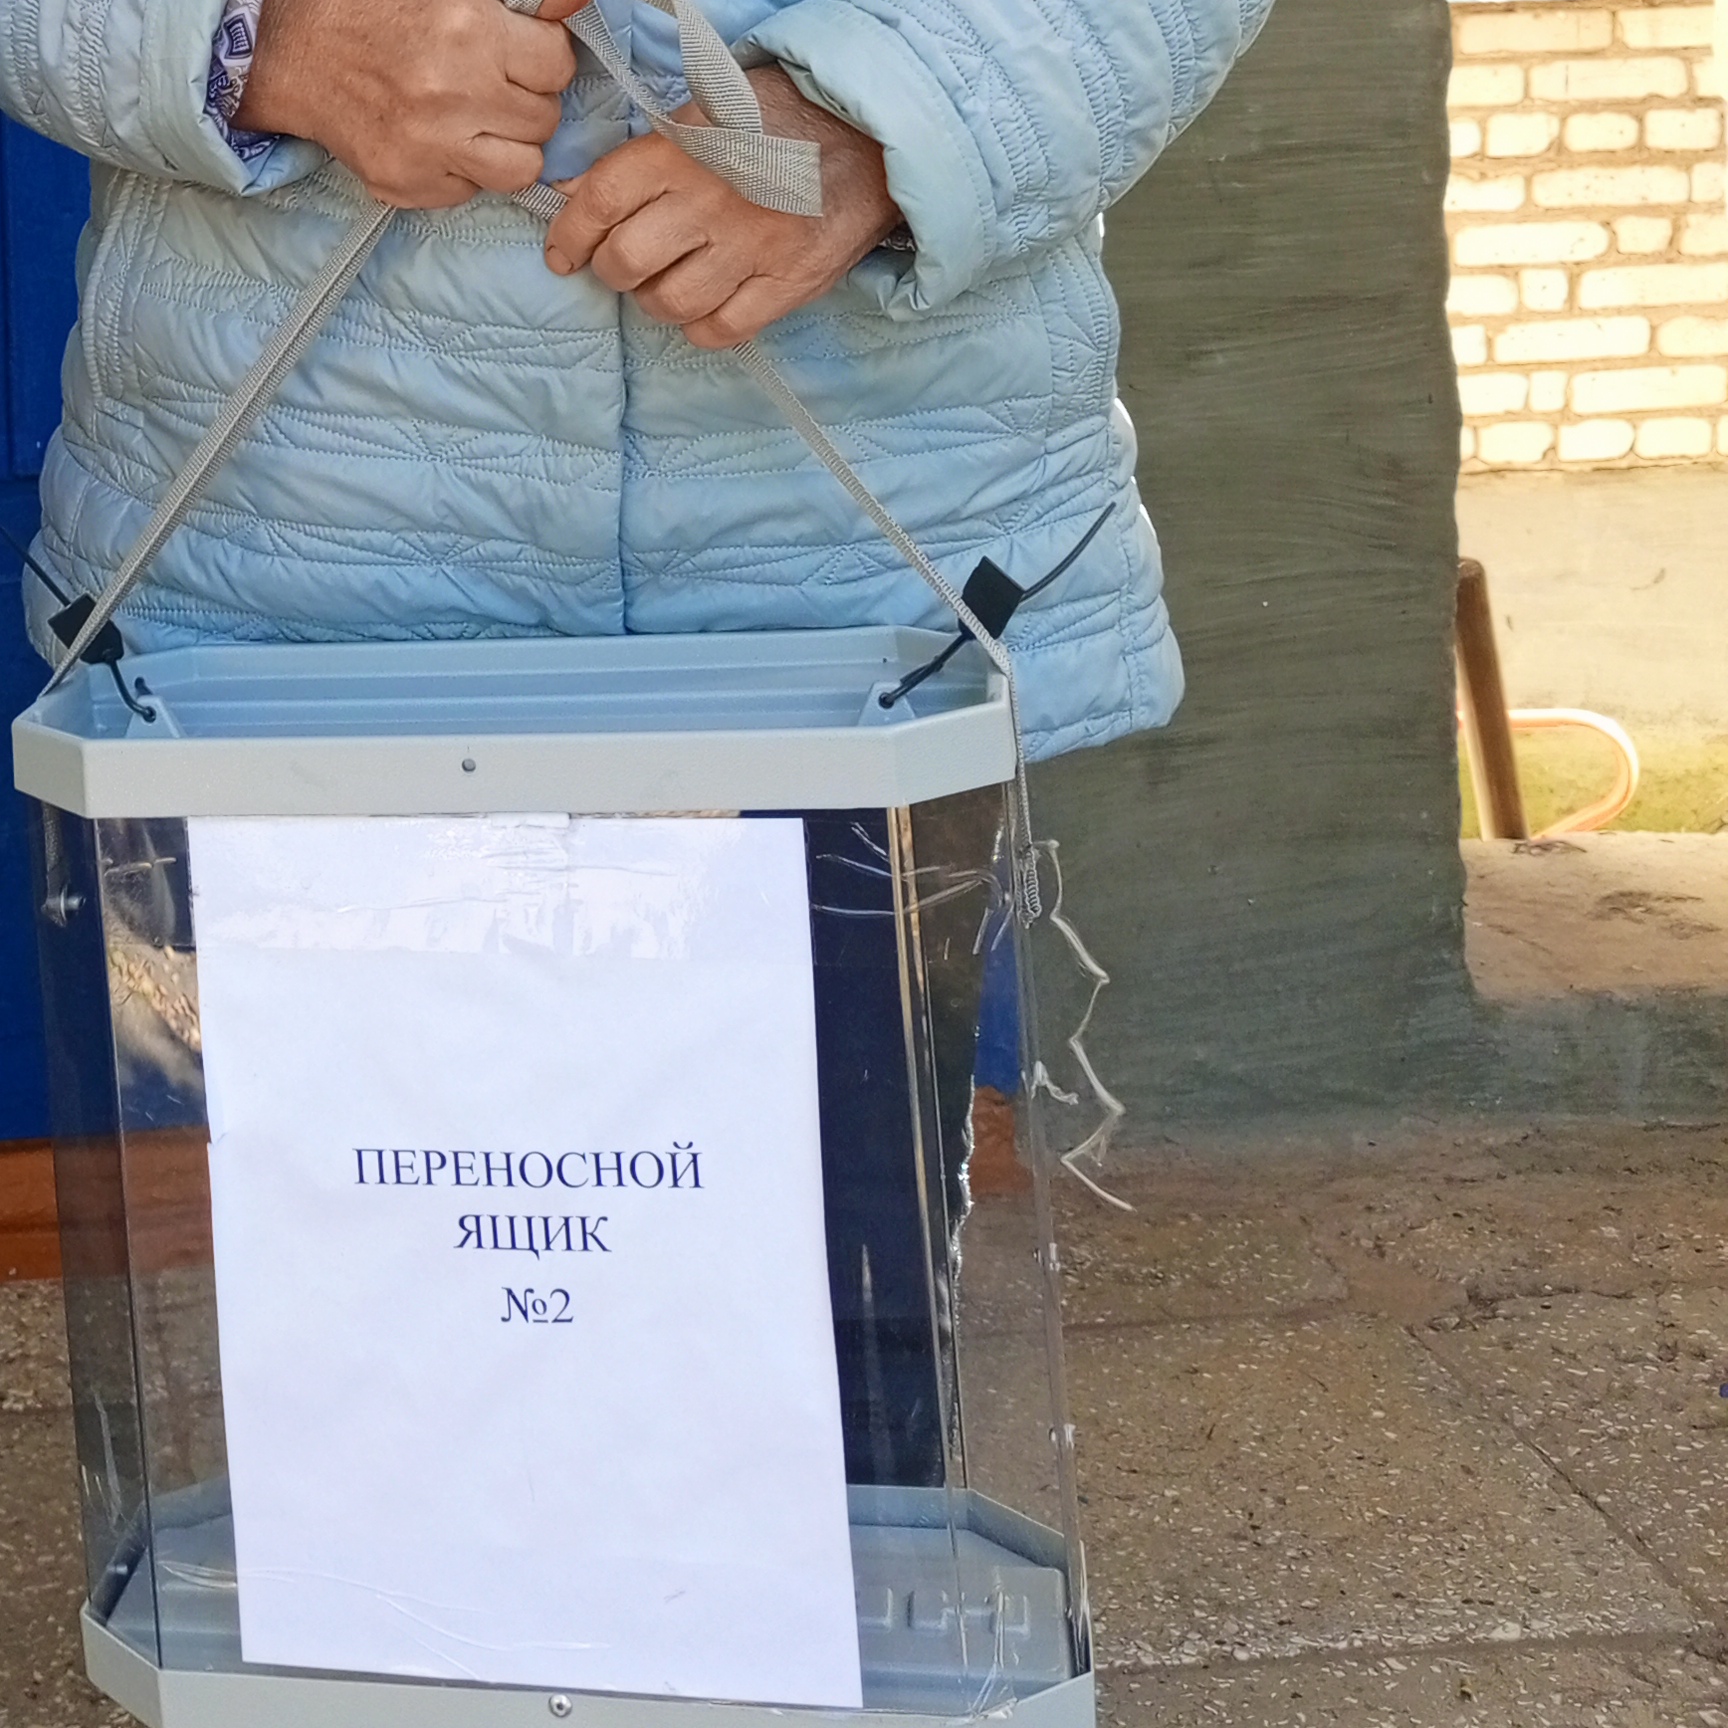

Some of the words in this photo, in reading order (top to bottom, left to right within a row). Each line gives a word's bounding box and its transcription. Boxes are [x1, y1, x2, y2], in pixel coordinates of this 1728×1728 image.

[353, 1140, 704, 1190] ПЕРЕНОСНОЙ
[453, 1213, 611, 1260] ЯЩИК
[500, 1286, 574, 1326] №2
